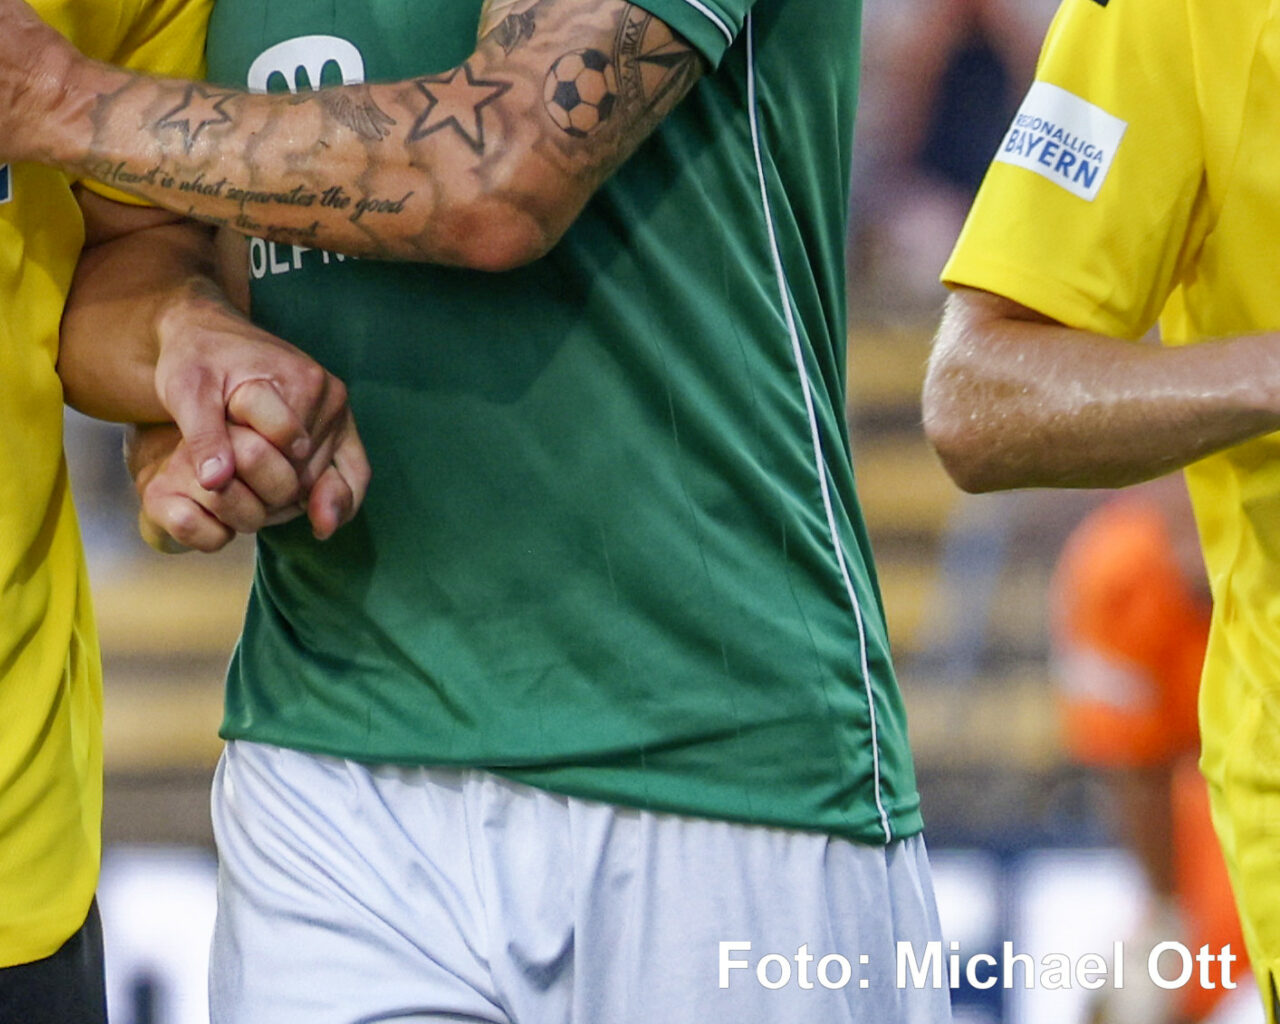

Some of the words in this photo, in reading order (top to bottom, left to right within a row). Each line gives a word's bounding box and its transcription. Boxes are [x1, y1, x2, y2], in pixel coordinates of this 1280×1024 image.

[1004, 128, 1100, 189] BAYERN
[160, 172, 176, 188] is
[179, 173, 233, 196] what
[224, 184, 317, 216] separates
[319, 185, 352, 210] the
[349, 191, 415, 222] good
